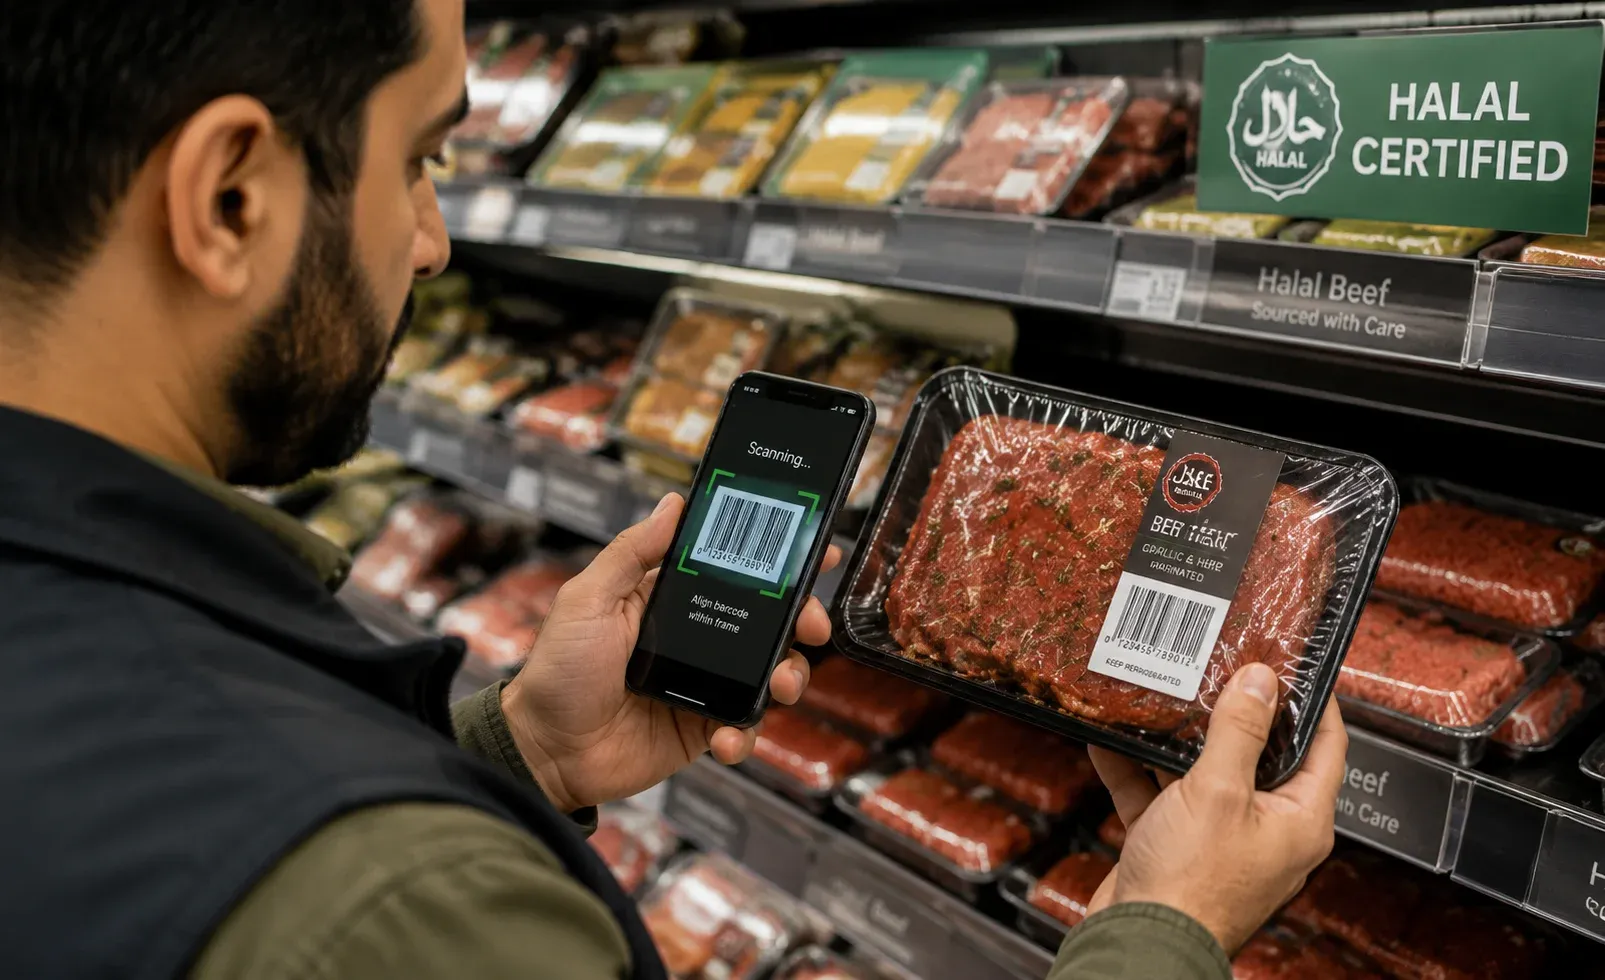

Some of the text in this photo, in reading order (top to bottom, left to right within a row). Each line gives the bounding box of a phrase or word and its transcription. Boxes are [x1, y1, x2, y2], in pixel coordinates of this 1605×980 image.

[1389, 81, 1530, 121] HALAL
[1255, 149, 1308, 169] HALAL
[1352, 136, 1569, 182] CERTIFIED
[1257, 266, 1392, 307] Halal Beef
[1251, 300, 1406, 339] Sourced with Care
[747, 441, 811, 469] Scanning...
[1343, 765, 1391, 797] eef
[1358, 803, 1400, 834] Care
